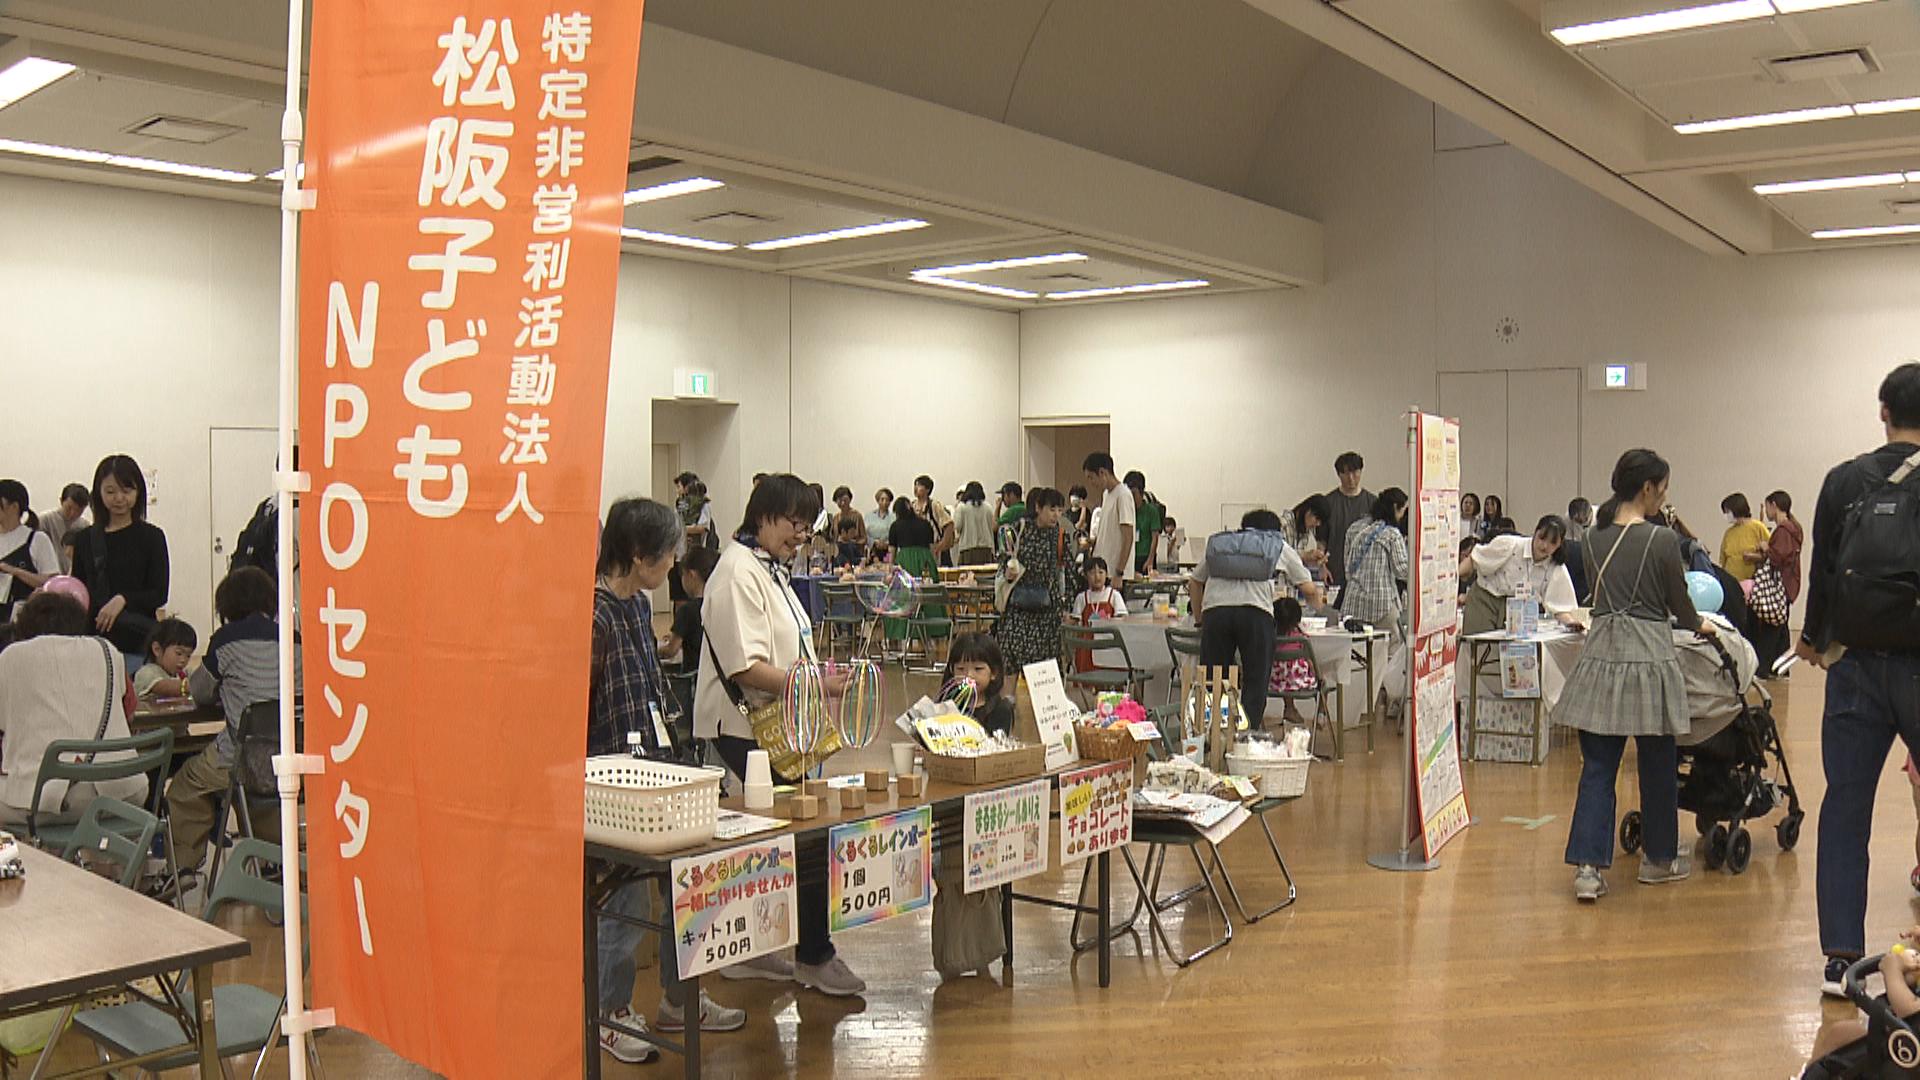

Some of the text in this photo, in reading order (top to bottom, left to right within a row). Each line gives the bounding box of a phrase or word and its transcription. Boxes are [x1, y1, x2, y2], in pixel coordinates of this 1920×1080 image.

[393, 16, 519, 519] 松阪子ども
[495, 12, 592, 524] 特定非営利活動法人
[318, 281, 379, 956] NPOセンター
[1067, 802, 1129, 838] チョコレート
[1089, 824, 1129, 851] あります
[835, 824, 927, 864] くるくるレインボー
[843, 867, 866, 889] 1個
[841, 886, 891, 915] 500円
[706, 937, 751, 964] 500円
